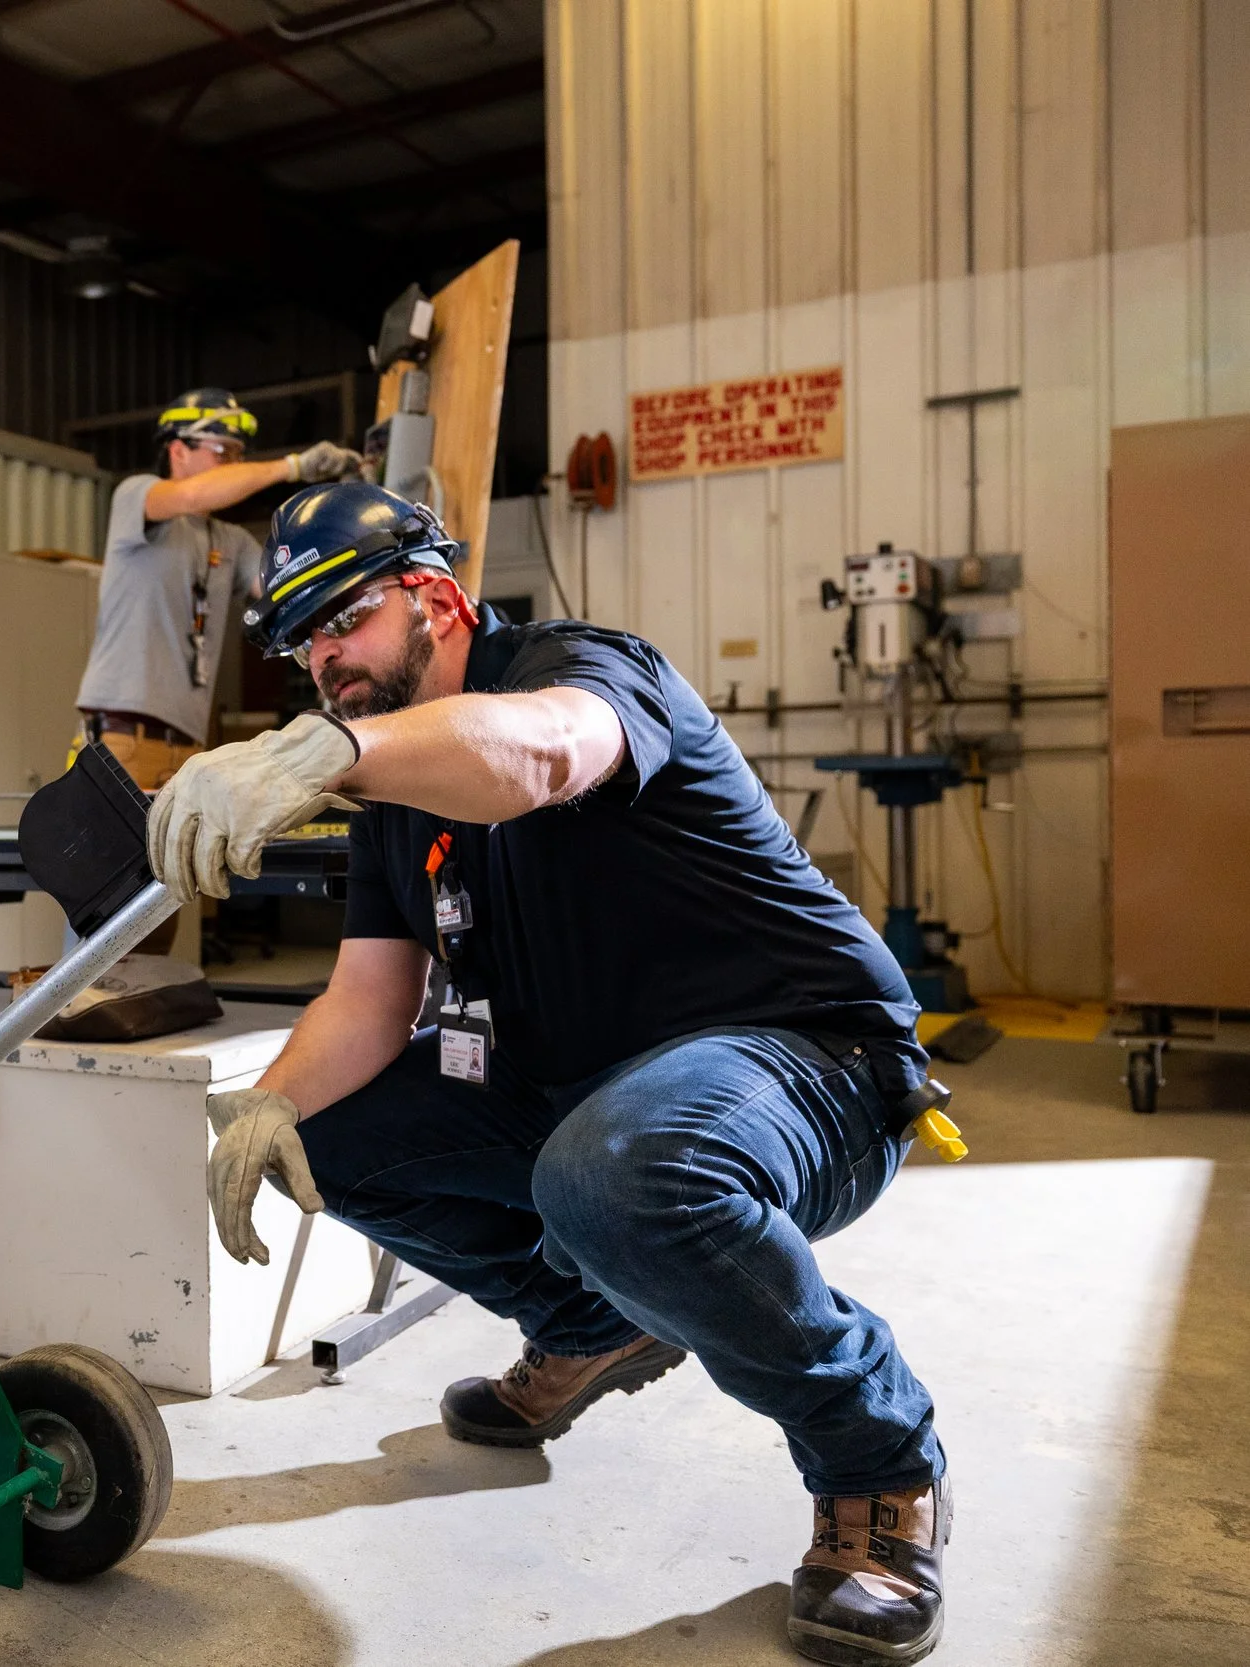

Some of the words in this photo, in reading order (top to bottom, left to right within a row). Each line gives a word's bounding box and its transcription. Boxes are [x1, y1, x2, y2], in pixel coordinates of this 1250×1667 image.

[724, 370, 842, 402] OPERATING
[634, 403, 745, 433] EQUIPMENT
[758, 402, 777, 418] IN
[791, 393, 837, 413] THIS
[697, 424, 763, 446] CHECK
[777, 416, 825, 436] WITH
[697, 438, 822, 466] PERSONNEL
